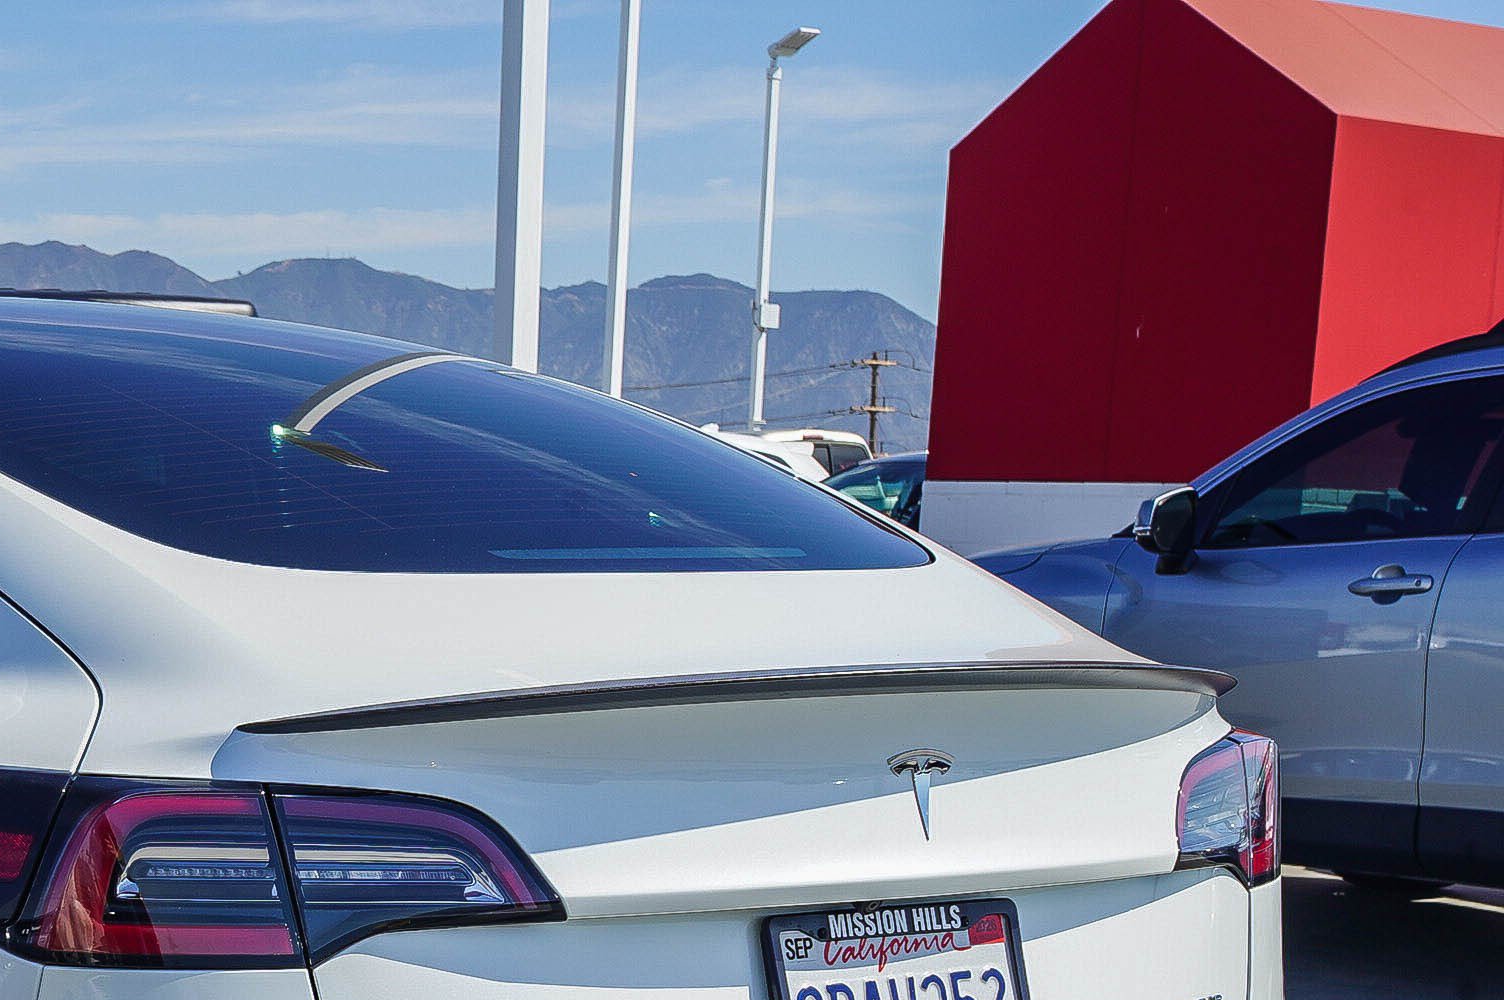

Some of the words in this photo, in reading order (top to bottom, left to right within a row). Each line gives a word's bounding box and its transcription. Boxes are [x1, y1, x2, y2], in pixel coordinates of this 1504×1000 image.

[827, 910, 907, 939] MISSION
[913, 904, 962, 931] HILLS
[784, 937, 814, 961] SEP
[822, 930, 973, 972] California
